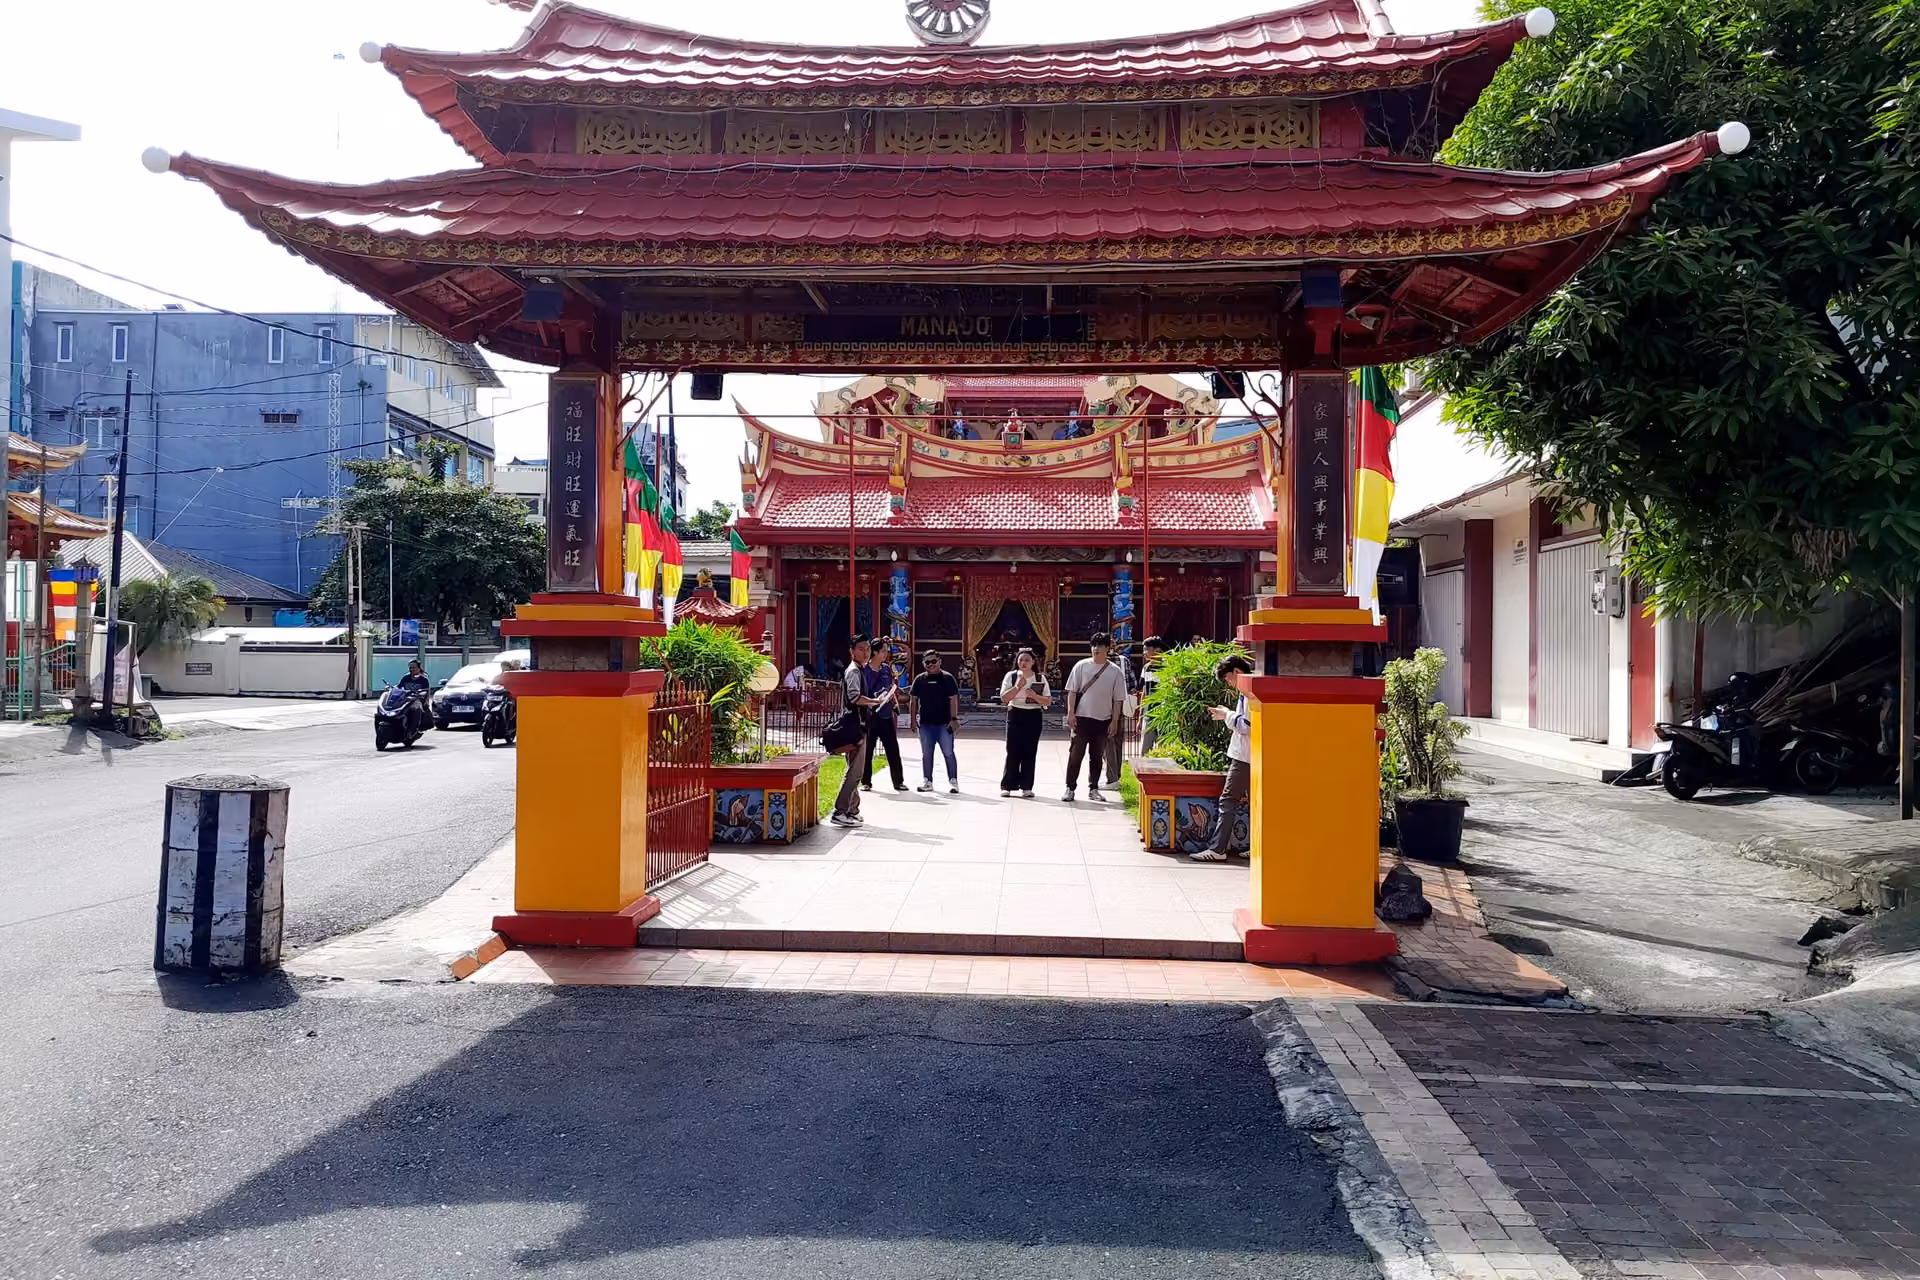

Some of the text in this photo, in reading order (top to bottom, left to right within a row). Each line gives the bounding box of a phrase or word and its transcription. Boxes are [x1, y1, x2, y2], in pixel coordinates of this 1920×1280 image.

[900, 316, 991, 335] MANADO
[564, 401, 583, 566] 福旺財旺運氣旺
[1312, 401, 1329, 564] 家興人興事業興
